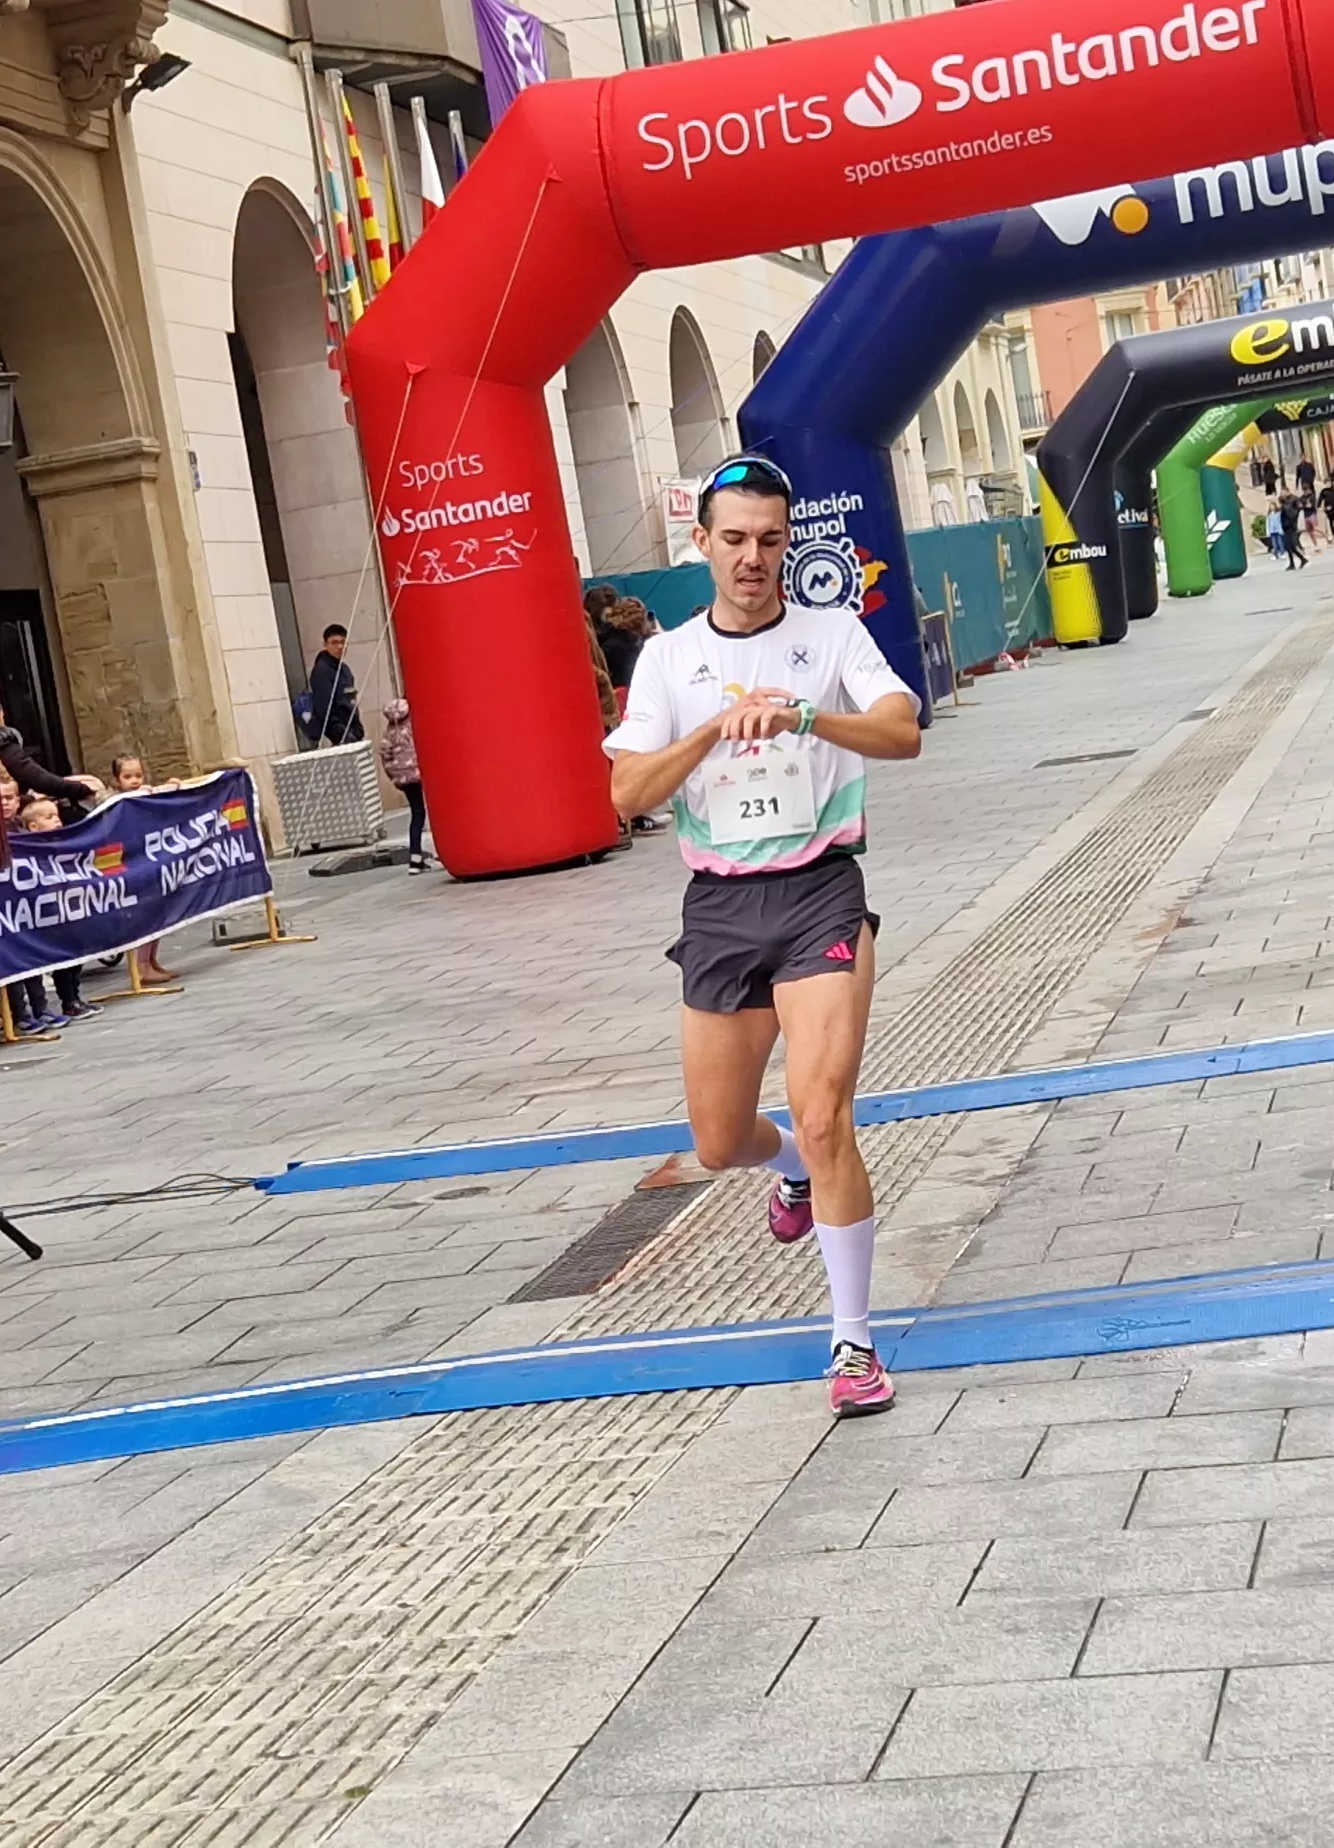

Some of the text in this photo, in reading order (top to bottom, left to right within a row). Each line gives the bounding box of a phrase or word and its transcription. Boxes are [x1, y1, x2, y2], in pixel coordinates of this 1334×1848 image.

[637, 1, 1266, 180] Sports Santander
[844, 125, 1054, 184] sportssantander.es
[1283, 366, 1295, 378] LA
[399, 452, 484, 491] Sports
[401, 490, 532, 534] Santander
[1054, 543, 1107, 563] embou
[739, 796, 779, 819] 231
[161, 834, 255, 897] NACIONAL
